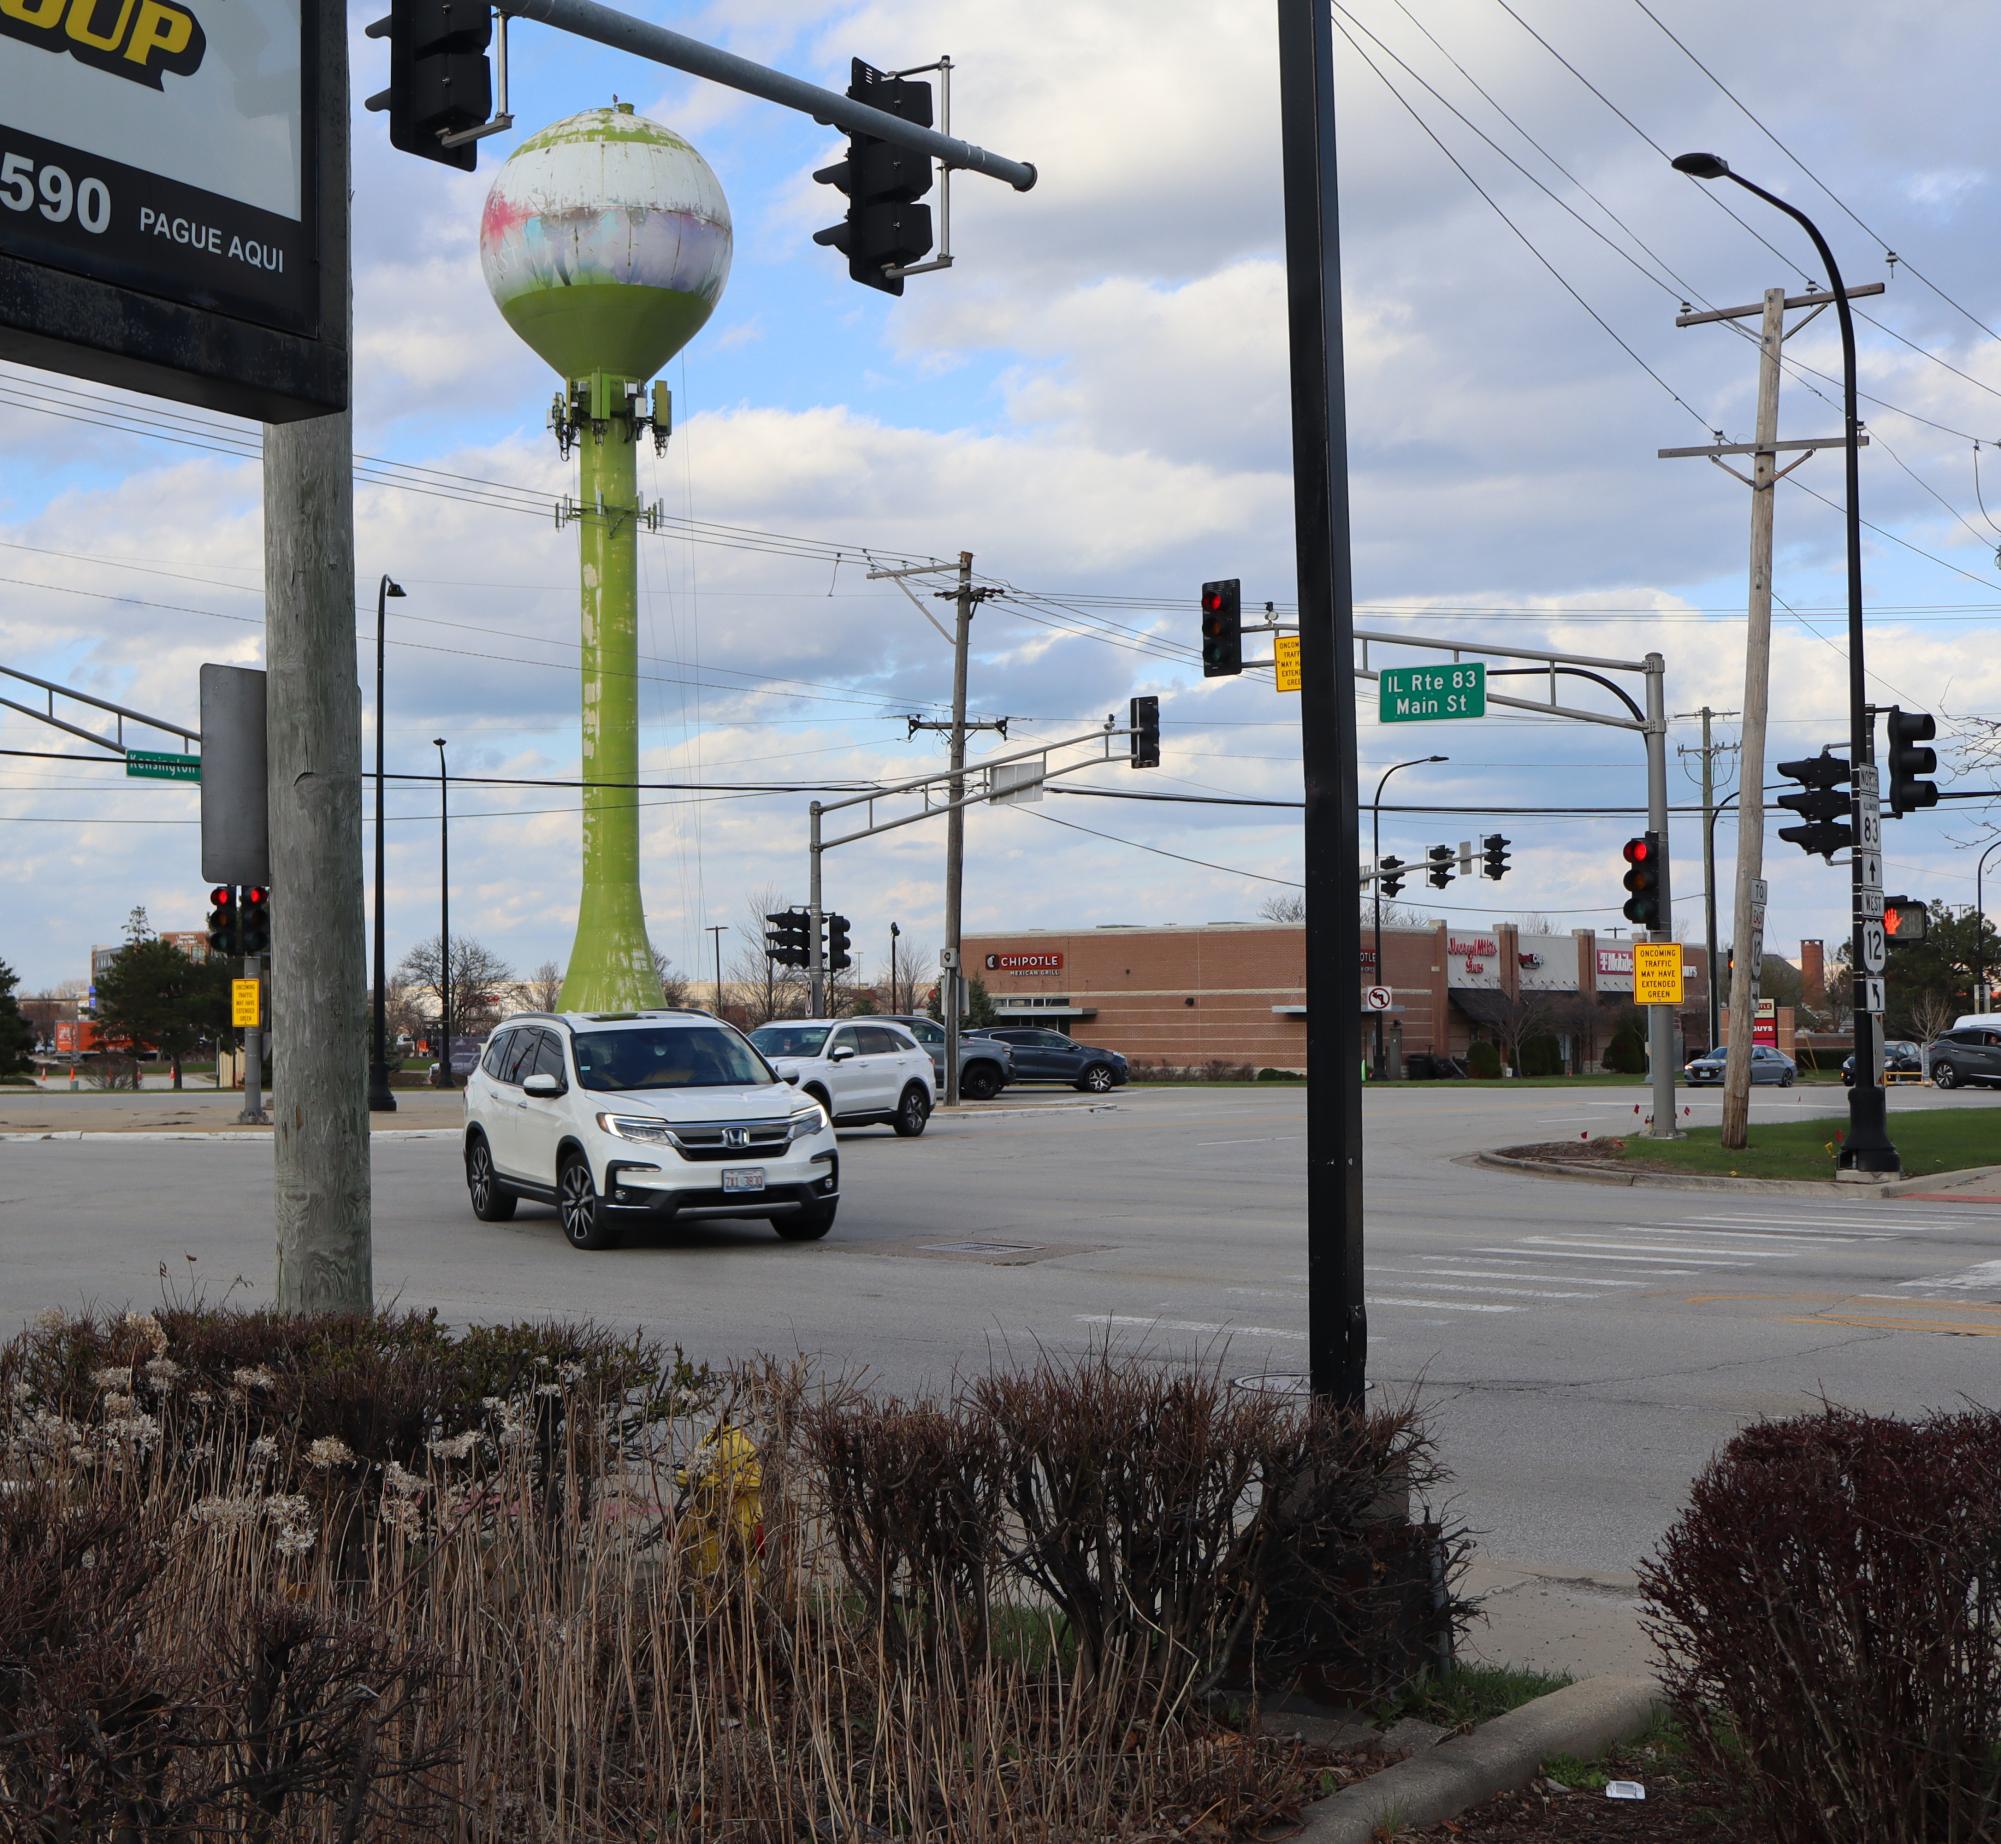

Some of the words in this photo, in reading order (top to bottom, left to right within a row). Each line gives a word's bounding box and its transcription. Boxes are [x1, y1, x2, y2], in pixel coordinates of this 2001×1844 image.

[0, 152, 111, 234] 590
[140, 207, 222, 255] PAGUE
[228, 235, 284, 273] AQUI
[1388, 676, 1403, 693] IL
[1411, 673, 1443, 691] Rte
[1453, 670, 1476, 688] 83
[1396, 698, 1438, 714] Main
[1447, 694, 1466, 712] St
[130, 753, 196, 776] Kensington
[1864, 817, 1878, 843] 83
[1755, 884, 1764, 898] TO
[1865, 894, 1882, 911] WEST
[1640, 949, 1676, 957] ONCOMING
[1754, 940, 1760, 967] 12
[1867, 930, 1882, 960] 12
[1001, 956, 1058, 966] CHIPOTLE
[1658, 969, 1676, 977] HAVE
[1641, 980, 1676, 988] EXTENDED
[1647, 990, 1670, 998] GREEN
